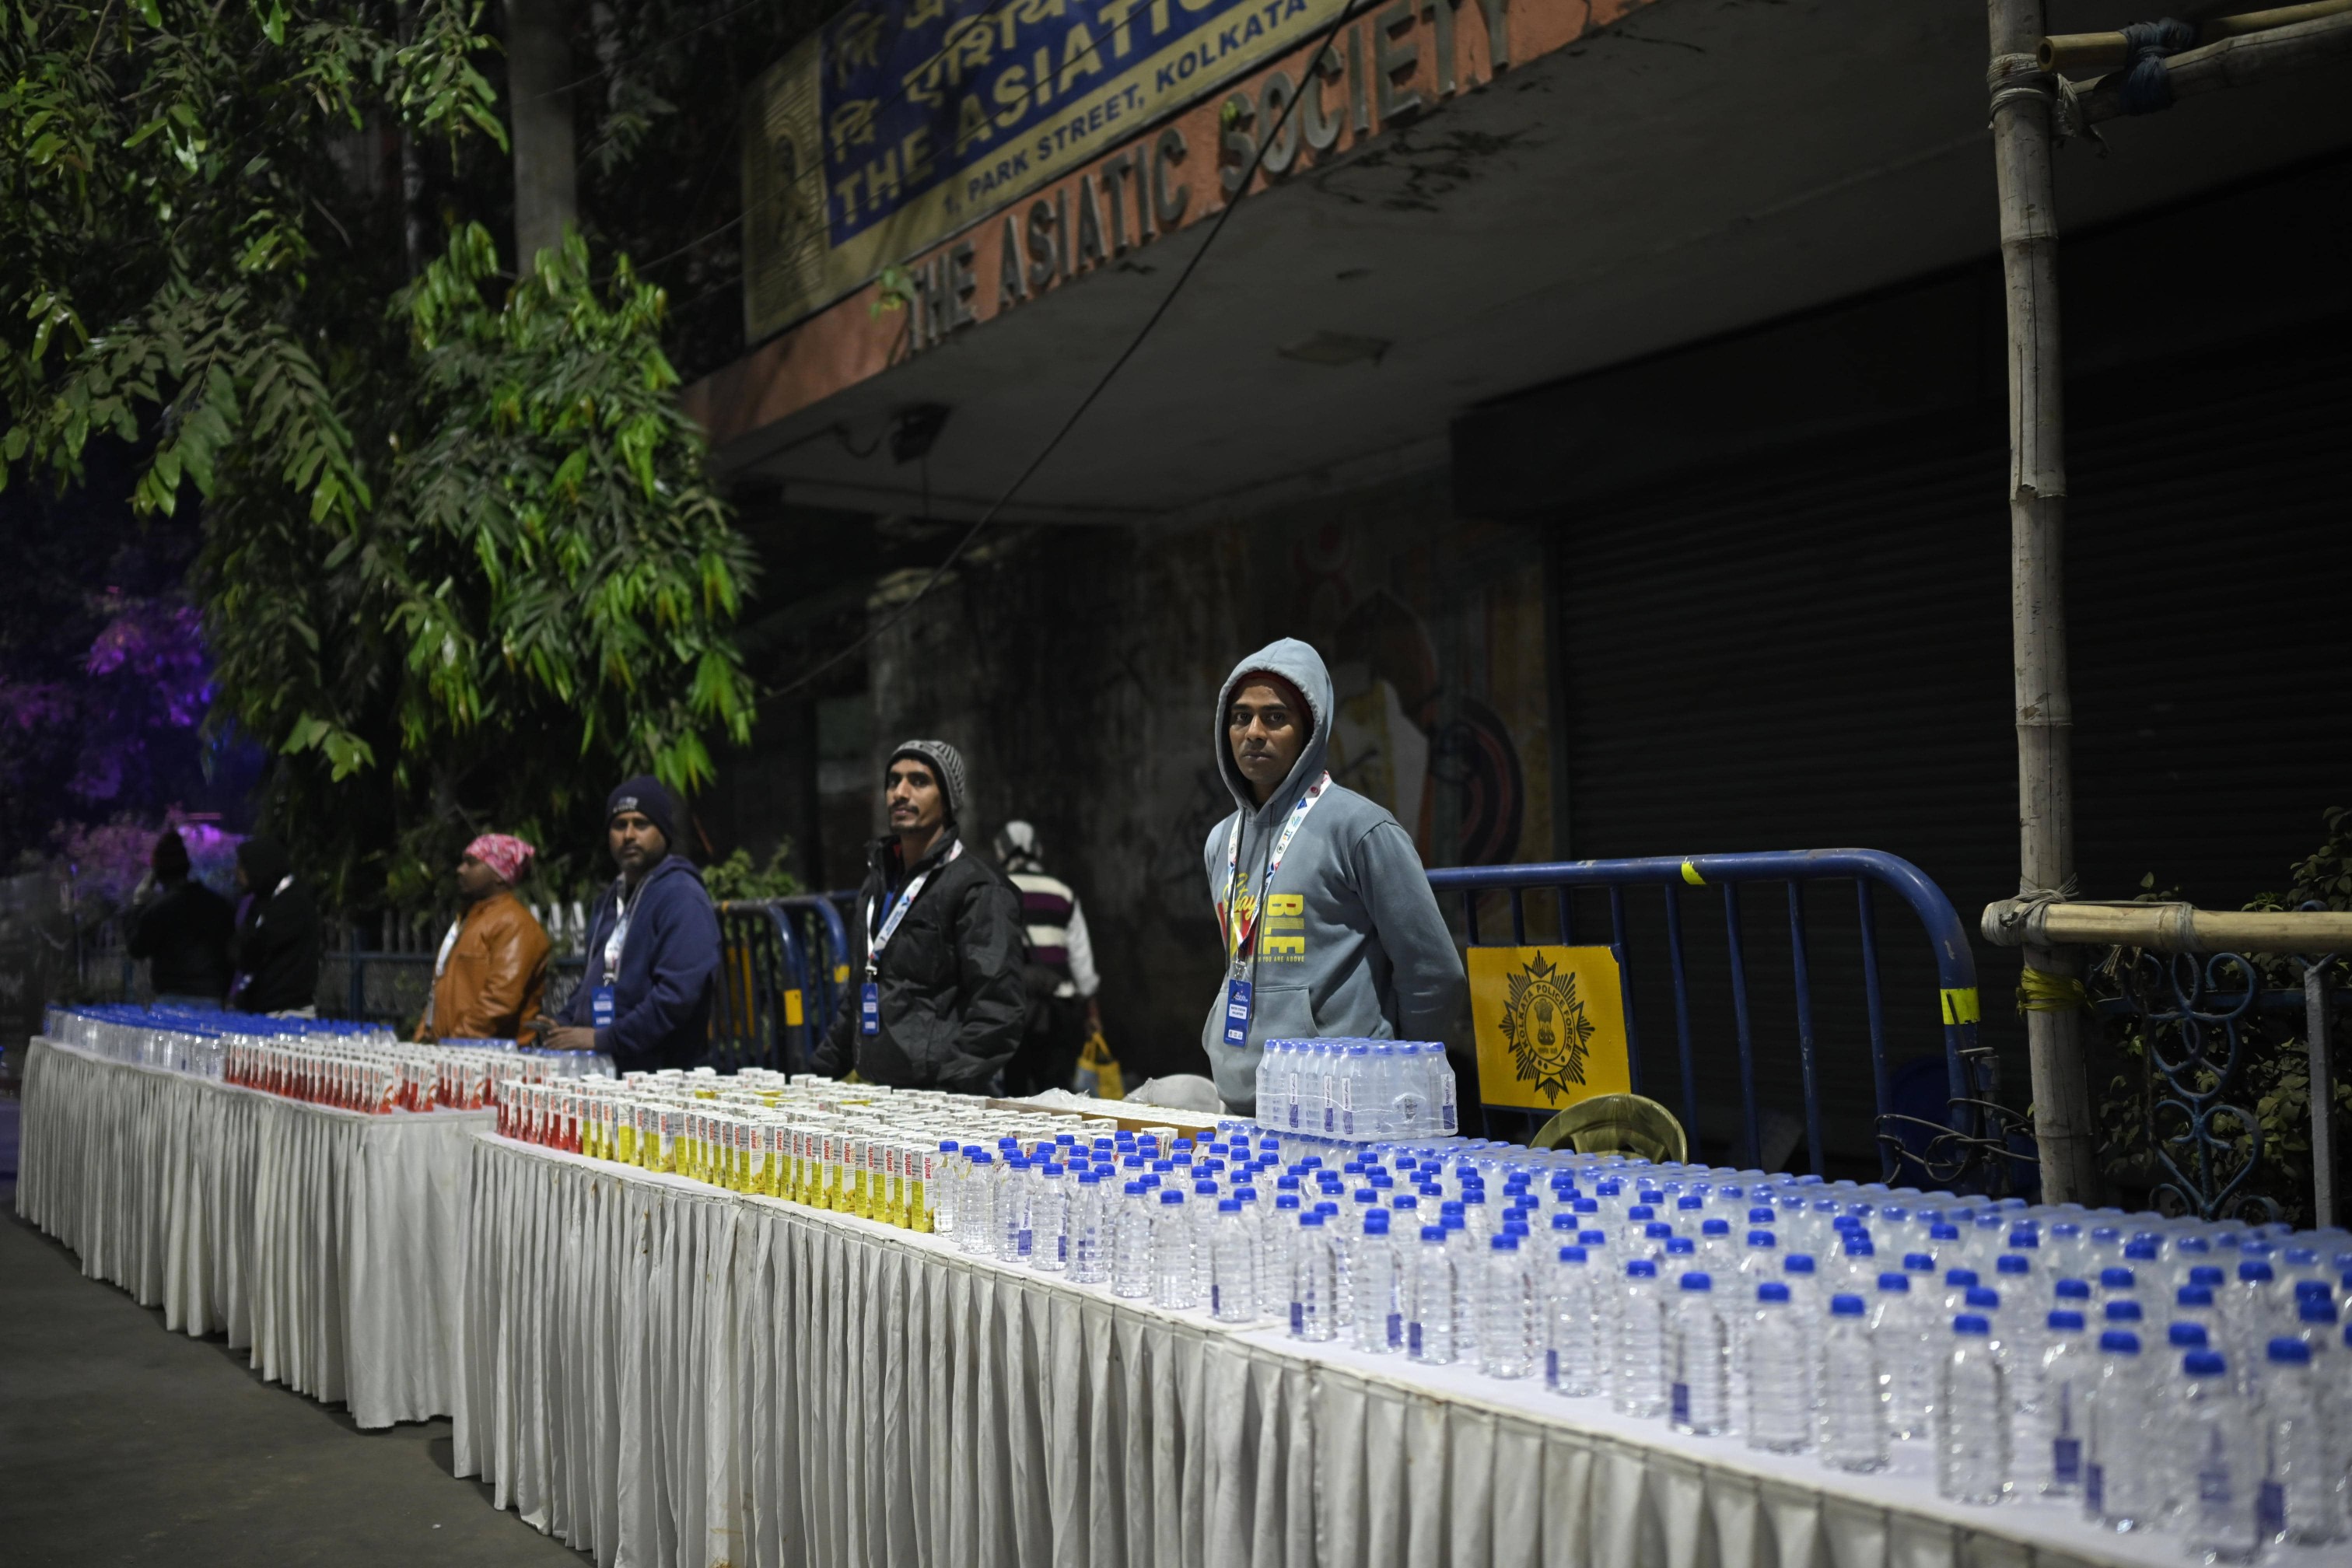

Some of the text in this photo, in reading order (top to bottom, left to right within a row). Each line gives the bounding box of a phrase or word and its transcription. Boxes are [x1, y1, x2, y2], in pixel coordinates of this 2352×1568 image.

[835, 0, 1227, 225] THE ASIATI
[968, 149, 1029, 201] PARK
[1037, 83, 1145, 160] STREET,
[1156, 0, 1307, 92] KOLKATA
[908, 240, 978, 350] THE
[999, 128, 1188, 308] ASIATIC
[1518, 985, 1573, 1052] KOLKATA POLICE FORCE
